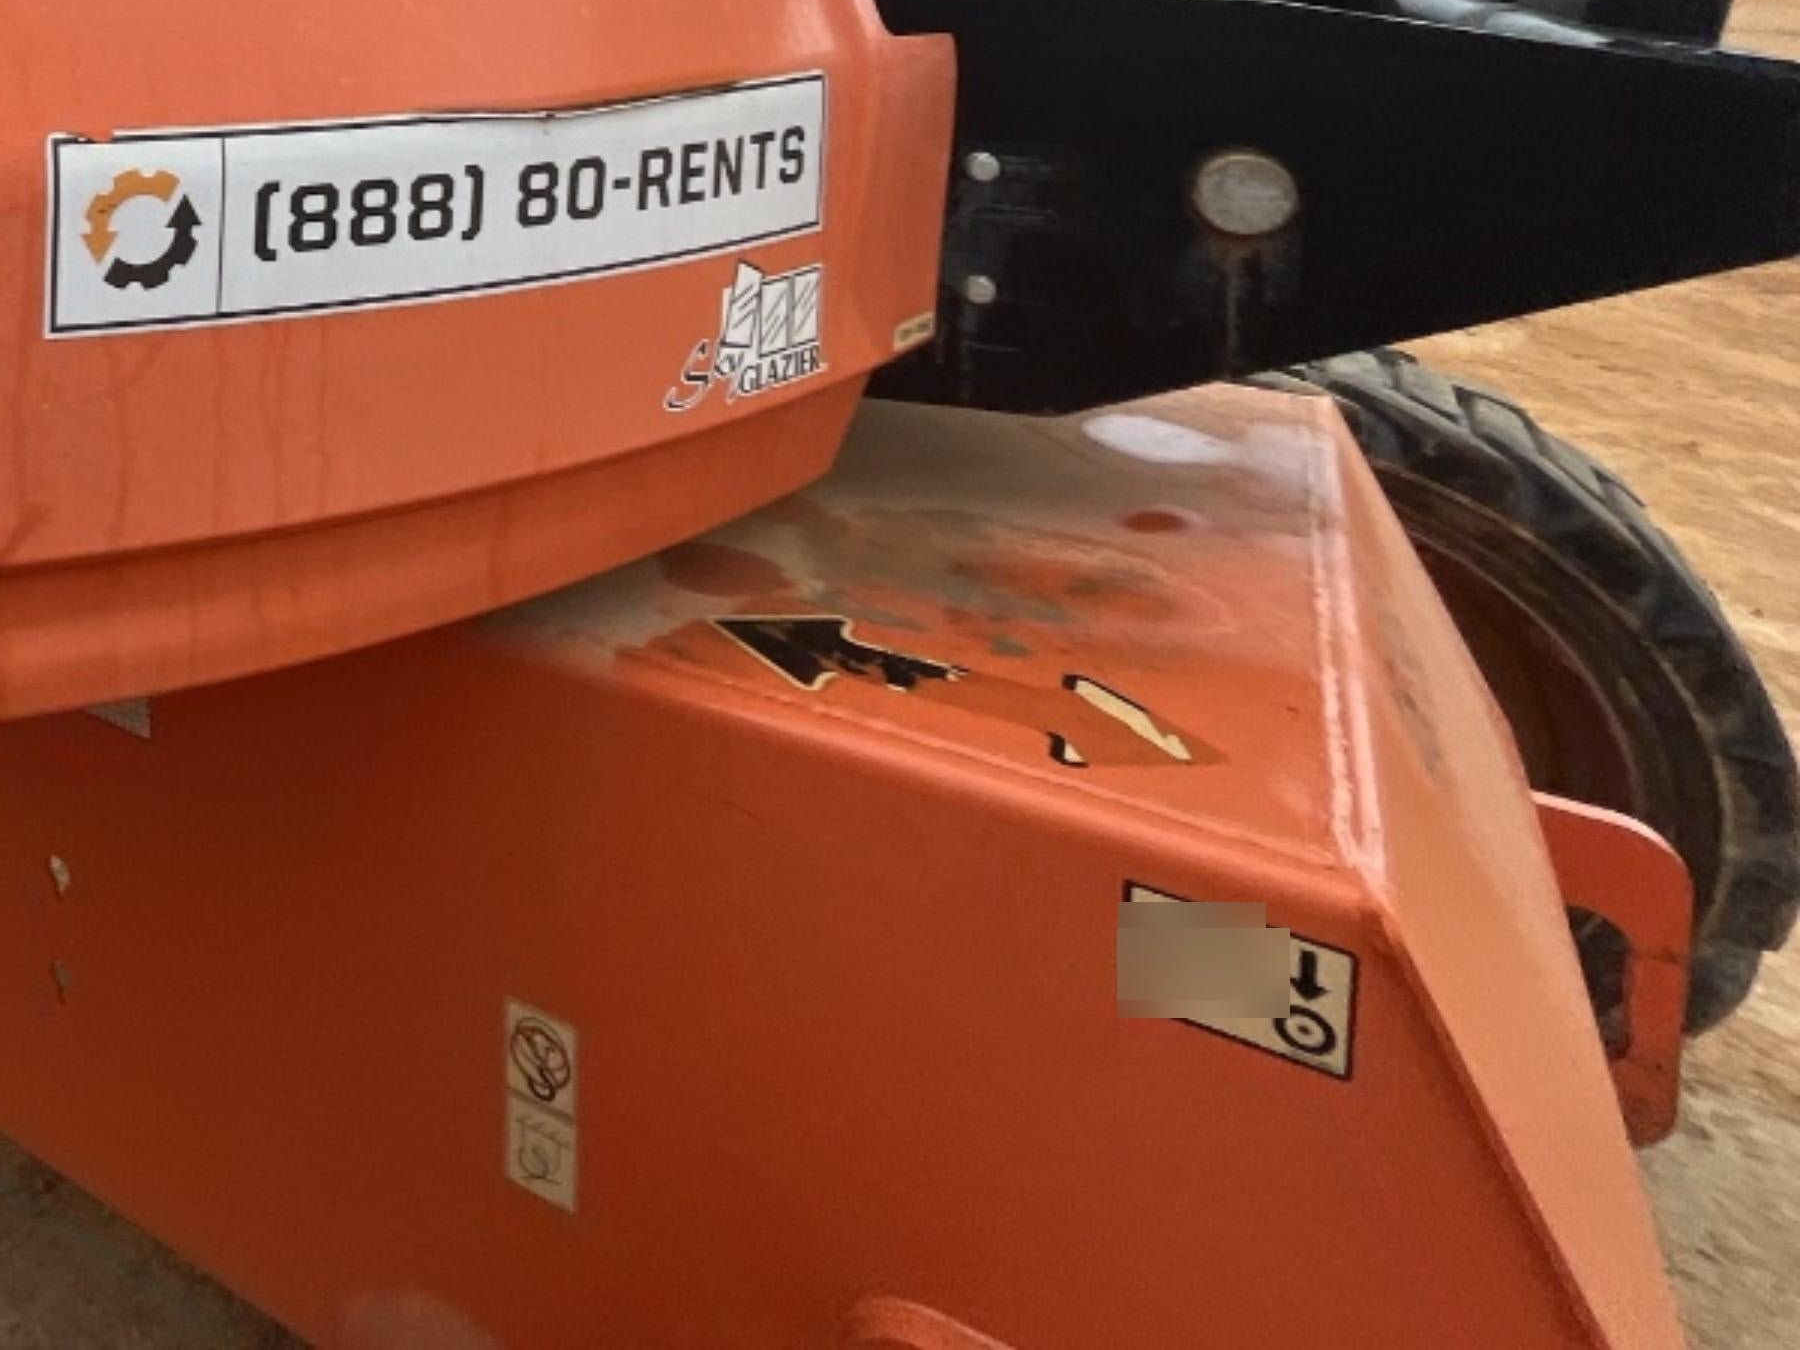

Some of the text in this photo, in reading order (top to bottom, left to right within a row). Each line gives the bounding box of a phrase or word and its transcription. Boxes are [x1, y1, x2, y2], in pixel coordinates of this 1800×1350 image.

[253, 125, 806, 263] (888) 80-RENTS
[740, 345, 821, 394] GLAZIER
